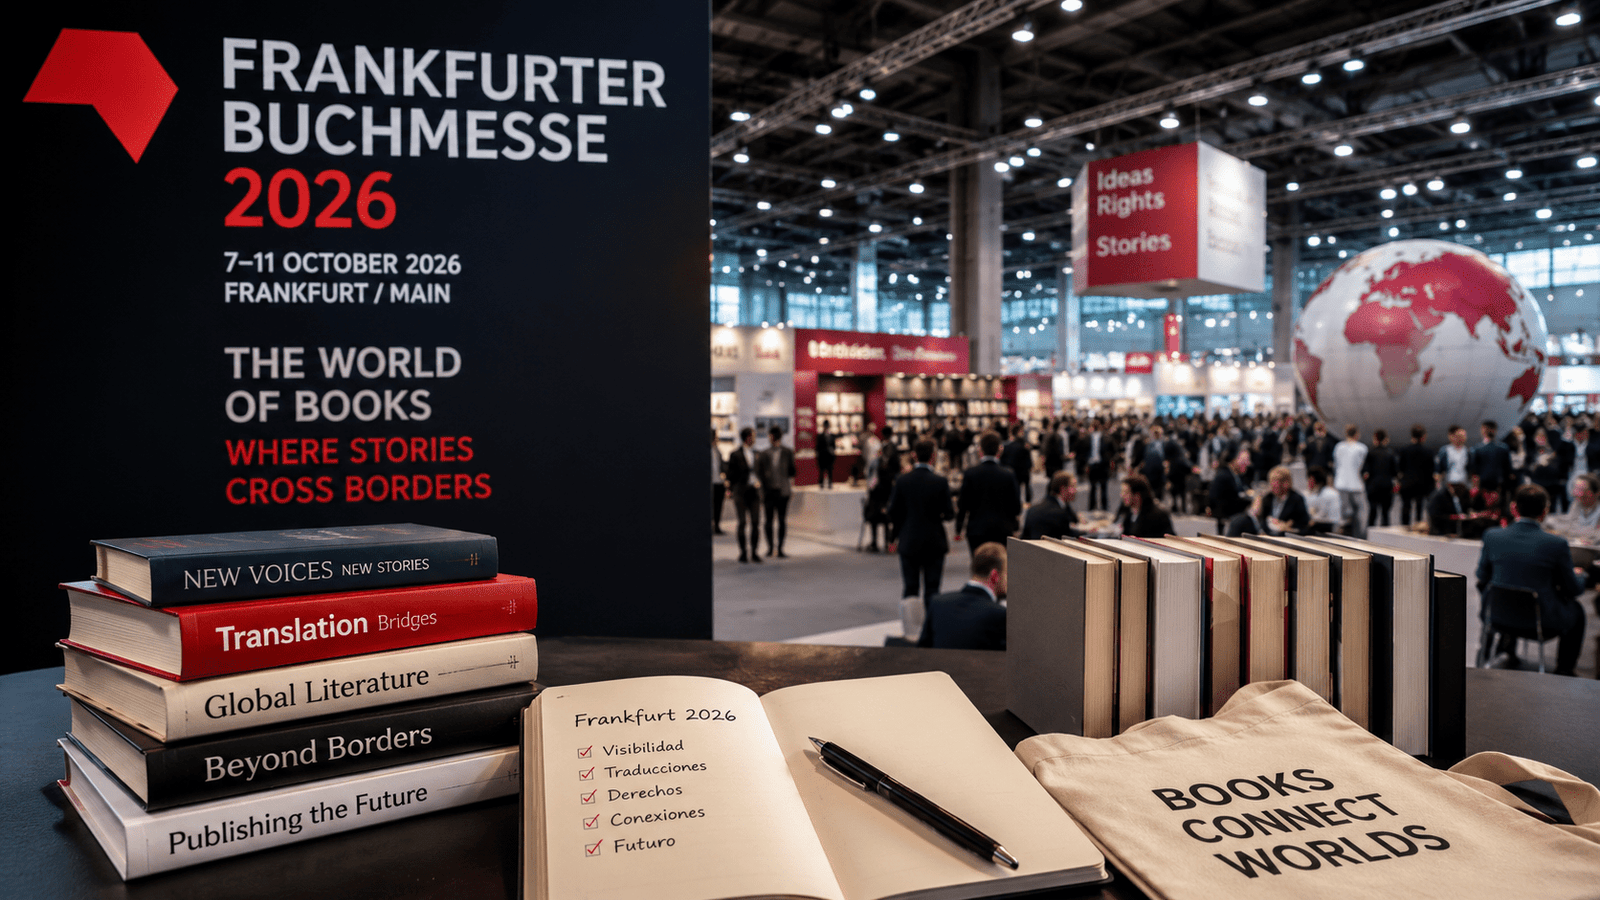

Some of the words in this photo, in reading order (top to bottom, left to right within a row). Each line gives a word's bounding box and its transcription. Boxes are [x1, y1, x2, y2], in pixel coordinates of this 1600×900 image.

[222, 37, 667, 108] FRANKFURTER
[223, 100, 609, 163] BUCHMESSE
[1096, 167, 1155, 191] Ideas
[223, 167, 397, 230] 2026
[1097, 191, 1166, 219] Rights
[1096, 232, 1172, 257] Stories
[282, 252, 399, 275] OCTOBER
[405, 254, 462, 275] 2026
[224, 282, 368, 304] FRANKFURT
[373, 282, 384, 304] /
[390, 283, 451, 304] MAIN
[224, 346, 305, 379] THE
[317, 346, 463, 379] WORLD
[225, 389, 280, 423] OF
[295, 389, 432, 422] BOOKS
[225, 438, 339, 465] WHERE
[350, 436, 474, 463] STORIES
[225, 477, 334, 504] CROSS
[345, 473, 492, 502] BORDERS
[183, 566, 241, 590] NEW
[248, 560, 333, 585] VOICES
[341, 563, 373, 577] NEW
[377, 558, 430, 574] STORIES
[215, 614, 368, 652] Translation
[378, 611, 437, 633] Bridges
[204, 680, 297, 720] Global
[305, 669, 430, 703] Literature
[575, 708, 676, 727] Frankfurt
[685, 708, 737, 722] 2026
[204, 738, 317, 783] Beyond
[327, 726, 433, 760] Borders
[602, 740, 684, 756] Visibilidad
[604, 760, 707, 779] Traducciones
[607, 785, 683, 802] Derechos
[1151, 768, 1334, 811] BOOKS
[168, 811, 303, 855] Publishing
[309, 803, 348, 825] the
[355, 787, 428, 815] Future
[610, 807, 706, 827] Conexiones
[1182, 793, 1399, 843] CONNECT
[614, 836, 676, 853] Futuro
[1213, 825, 1450, 879] WORLDS
